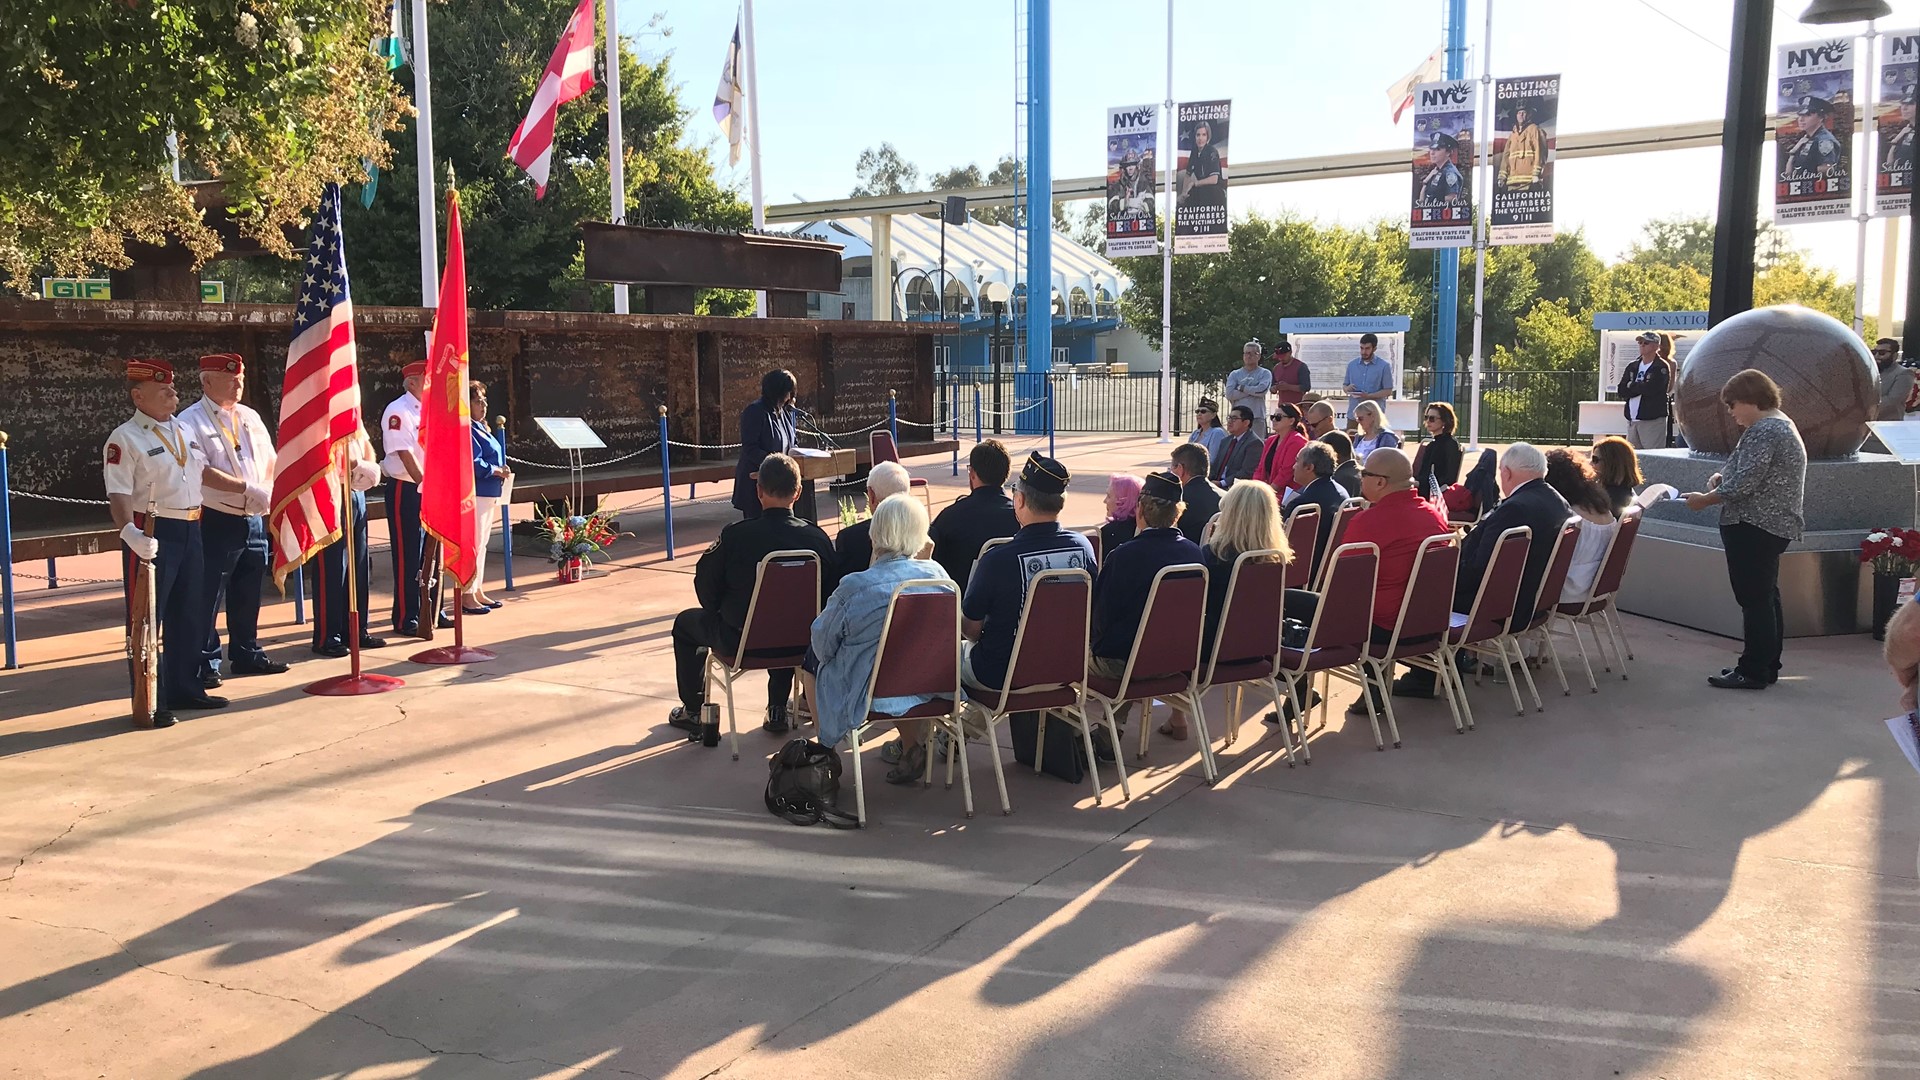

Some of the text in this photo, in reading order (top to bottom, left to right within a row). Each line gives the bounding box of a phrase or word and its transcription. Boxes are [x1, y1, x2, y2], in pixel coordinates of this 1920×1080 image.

[1788, 40, 1850, 69] NYC
[1498, 80, 1557, 92] SALUTING
[1422, 81, 1472, 106] NYC
[1498, 88, 1557, 99] OUR HEROES
[1180, 104, 1229, 115] SALUTING
[1113, 106, 1154, 129] NYC
[1180, 112, 1229, 122] OUR HEROES
[1779, 163, 1848, 182] Saluting Our
[1776, 178, 1851, 196] HEROES
[1495, 191, 1551, 200] CALIFORNIA
[1178, 205, 1225, 213] CALIFORNIA
[1414, 197, 1468, 210] Saluting Our
[1495, 199, 1551, 208] REMEMBERS
[1138, 209, 1152, 219] Our
[1178, 212, 1225, 220] REMEMBERS
[1412, 207, 1470, 222] HEROES
[1108, 219, 1154, 233] HEROES
[1627, 316, 1656, 326] ONE
